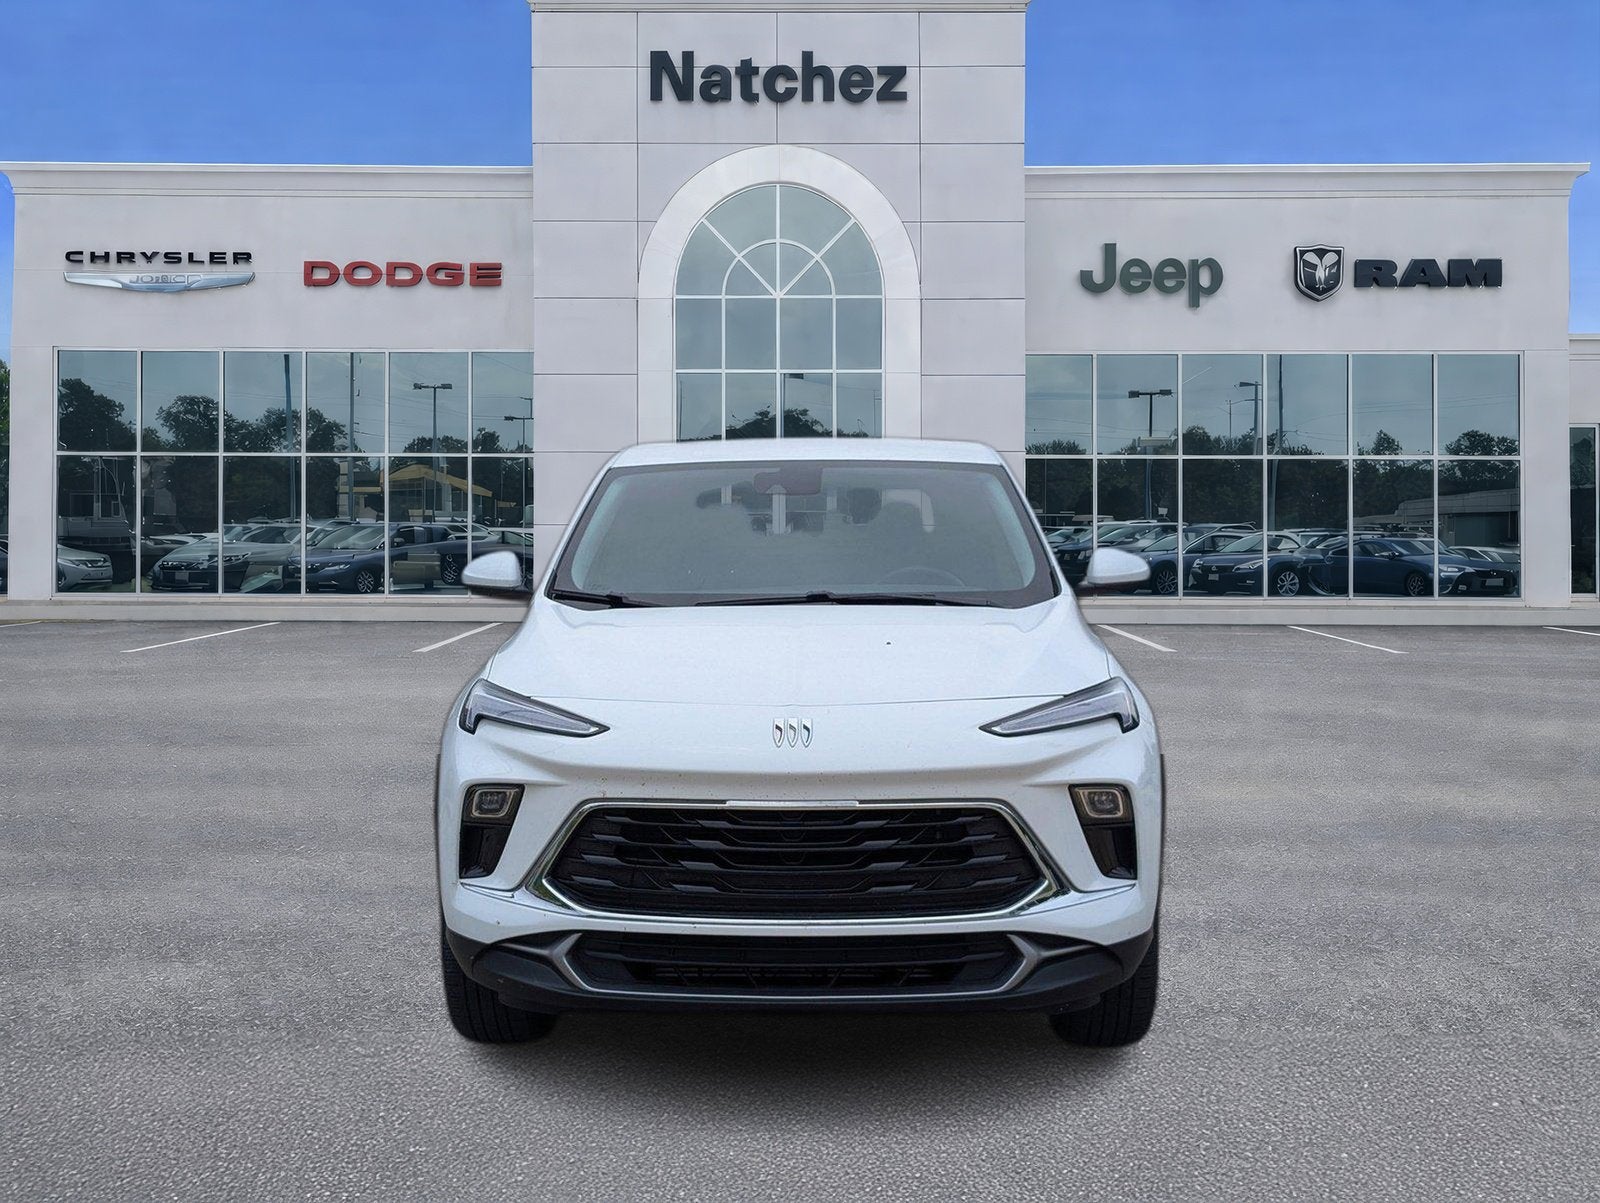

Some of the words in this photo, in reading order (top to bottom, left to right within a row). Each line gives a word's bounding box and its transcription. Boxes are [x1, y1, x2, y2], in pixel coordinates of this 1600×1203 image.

[650, 50, 907, 103] Natchez
[65, 250, 252, 264] CHRYSLER
[304, 260, 502, 287] DODGE
[1080, 243, 1223, 308] Jeep
[1353, 258, 1503, 288] RAM
